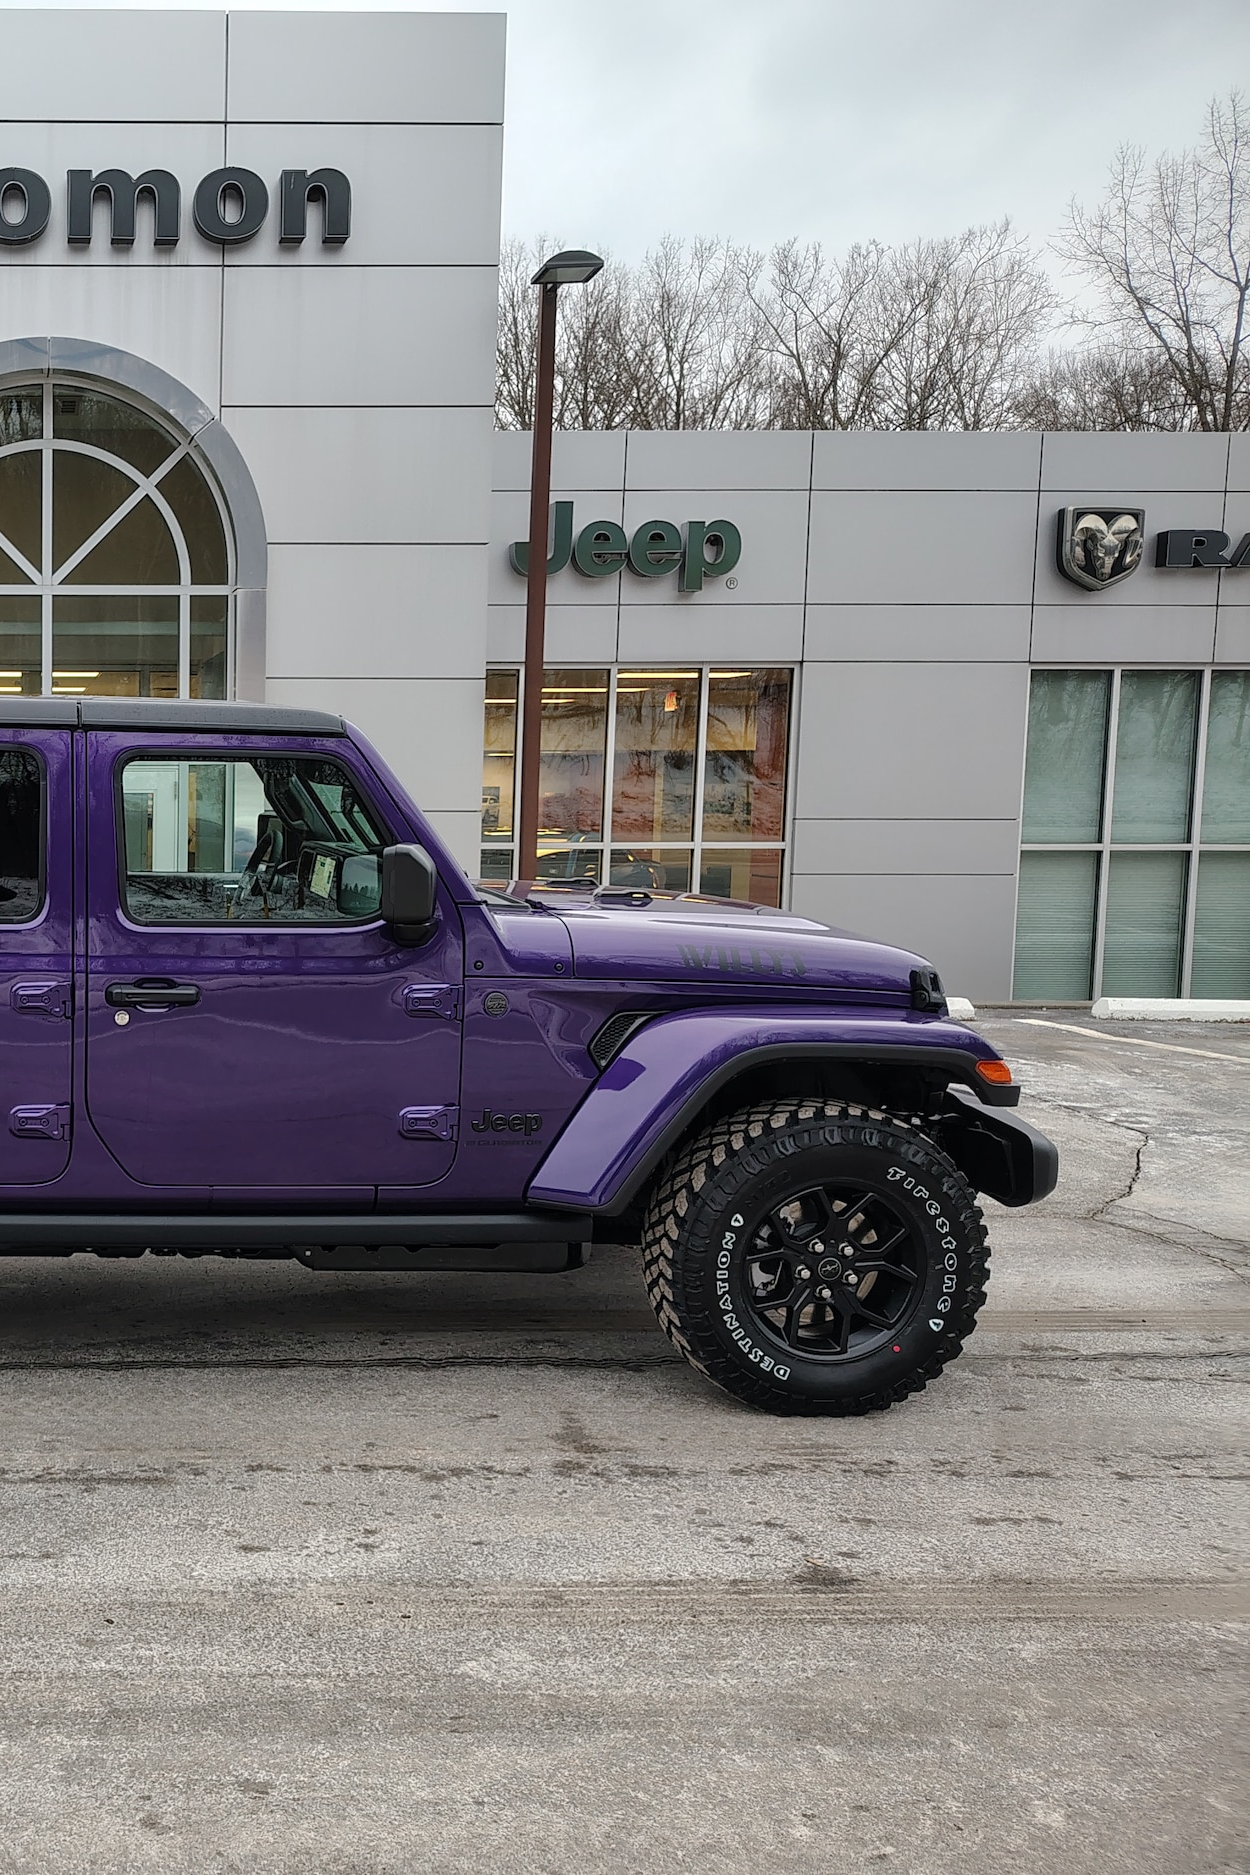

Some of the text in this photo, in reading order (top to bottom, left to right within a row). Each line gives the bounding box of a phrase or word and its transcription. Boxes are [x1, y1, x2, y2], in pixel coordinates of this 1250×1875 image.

[509, 500, 742, 592] Jeep
[1155, 529, 1250, 568] R
[675, 943, 807, 976] WILLYS
[471, 1107, 543, 1137] Jeep
[886, 1166, 957, 1313] Firestone
[716, 1234, 791, 1381] DESTINATION
